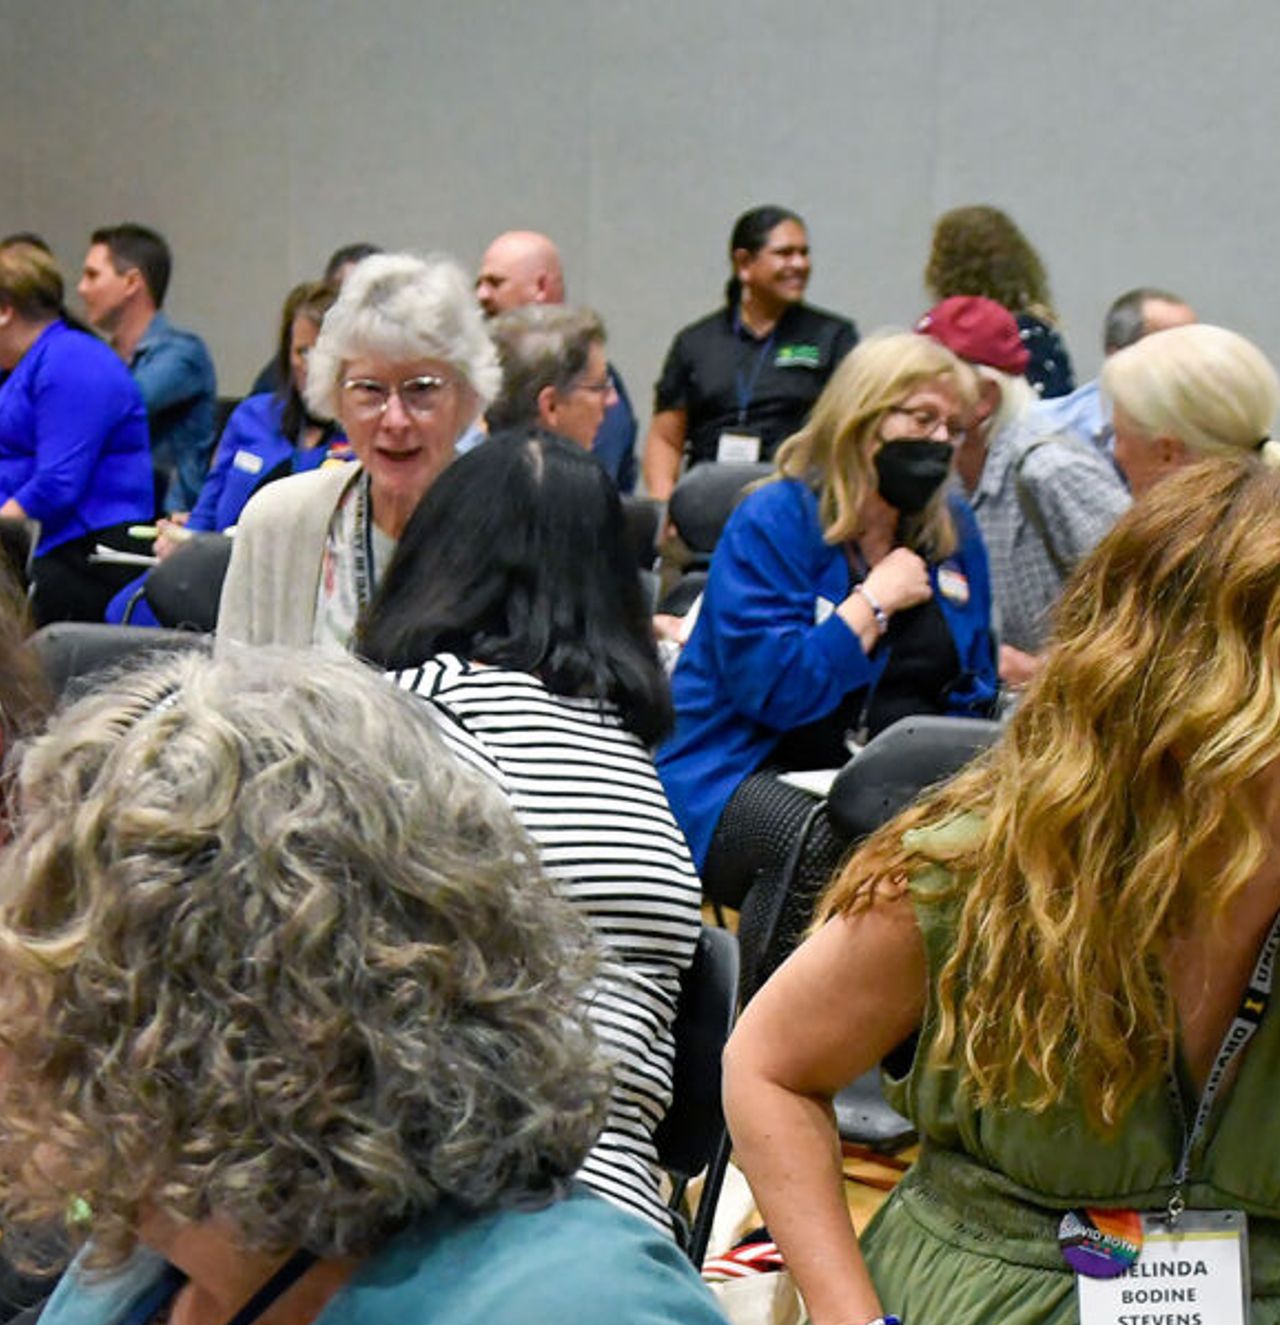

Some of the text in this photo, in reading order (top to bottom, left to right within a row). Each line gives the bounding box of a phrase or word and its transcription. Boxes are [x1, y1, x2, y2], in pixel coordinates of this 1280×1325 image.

[1207, 1026, 1248, 1094] IDAHO
[1104, 1234, 1138, 1254] ROTH
[1121, 1287, 1198, 1304] BODINE
